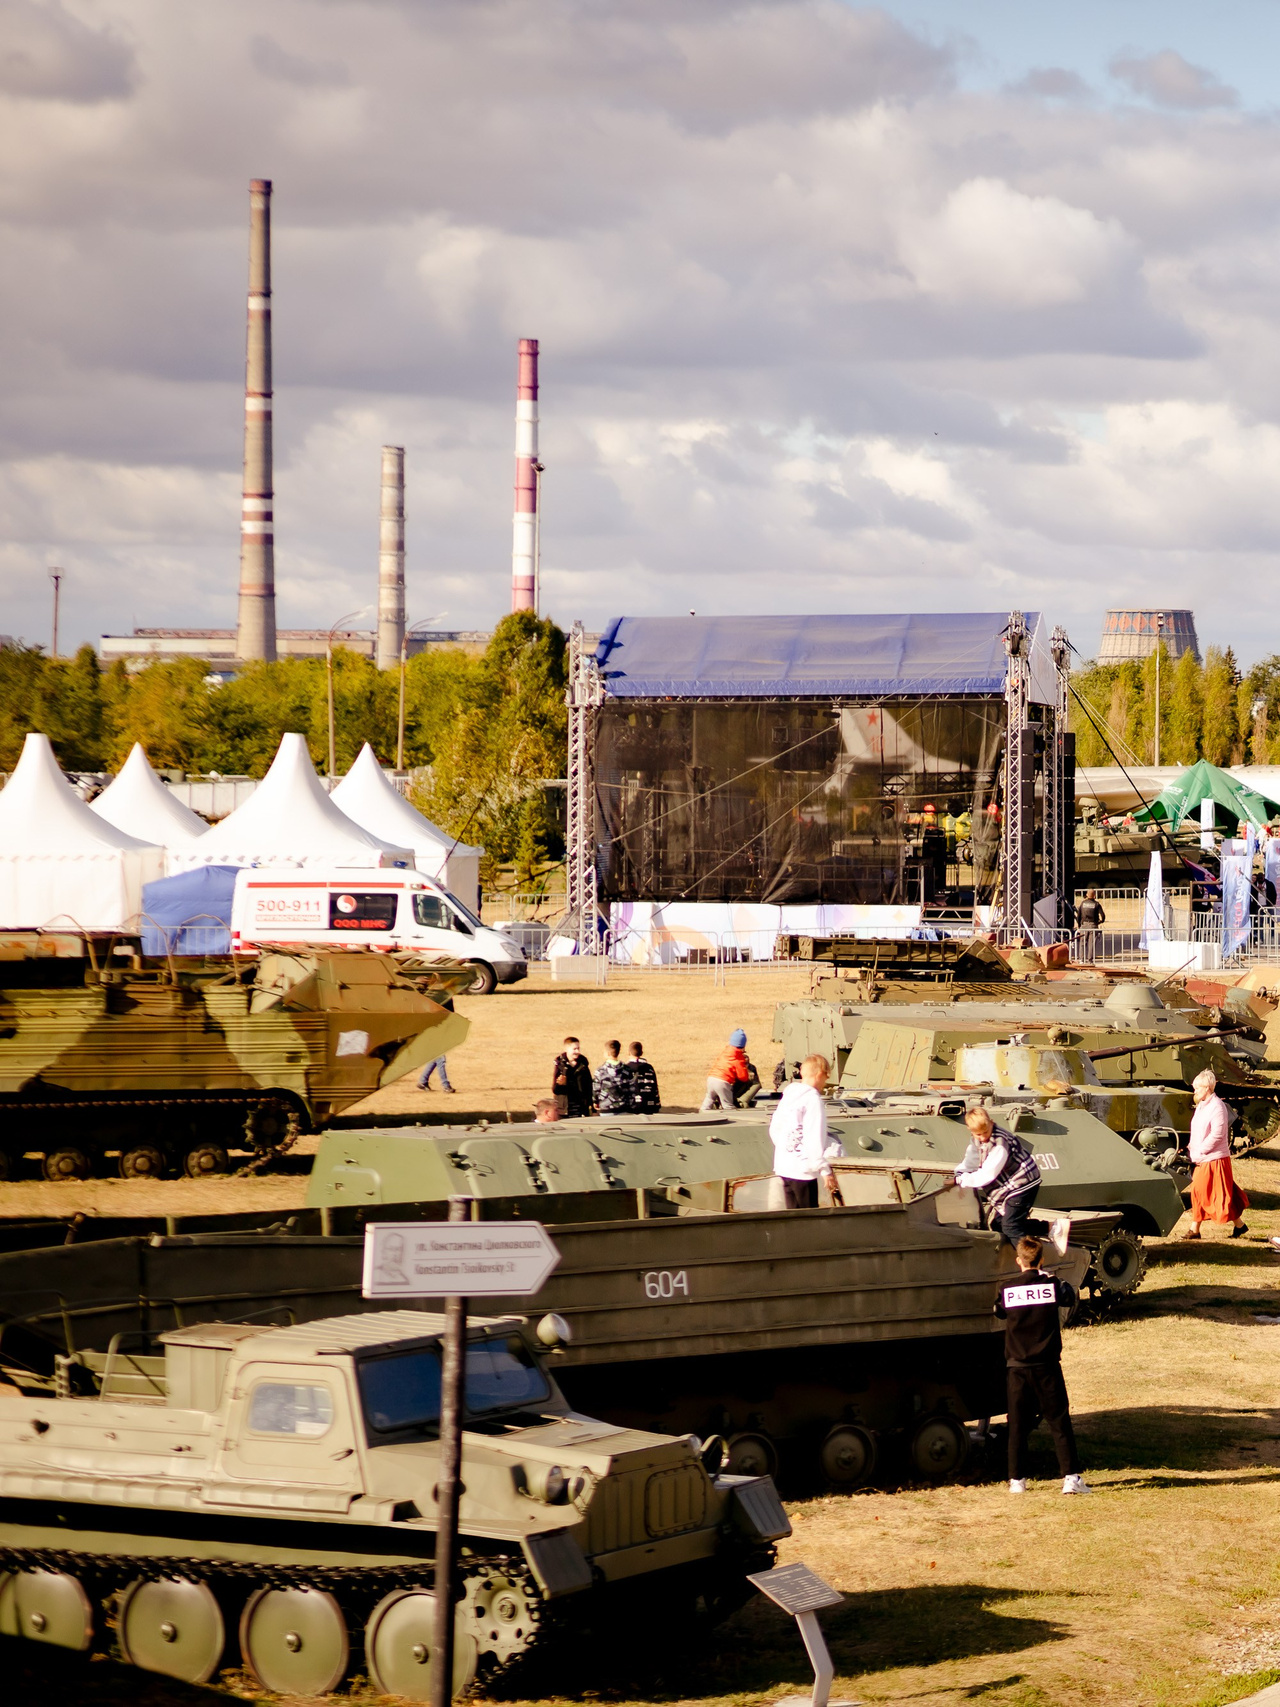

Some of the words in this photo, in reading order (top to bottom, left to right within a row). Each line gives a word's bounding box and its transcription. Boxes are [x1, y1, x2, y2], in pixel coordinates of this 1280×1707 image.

[257, 900, 320, 911] 500-911
[333, 919, 359, 928] ООО
[429, 1239, 483, 1251] Константина
[484, 1239, 541, 1251] Циолковского
[414, 1263, 458, 1274] Konstantin
[644, 1270, 688, 1299] 604
